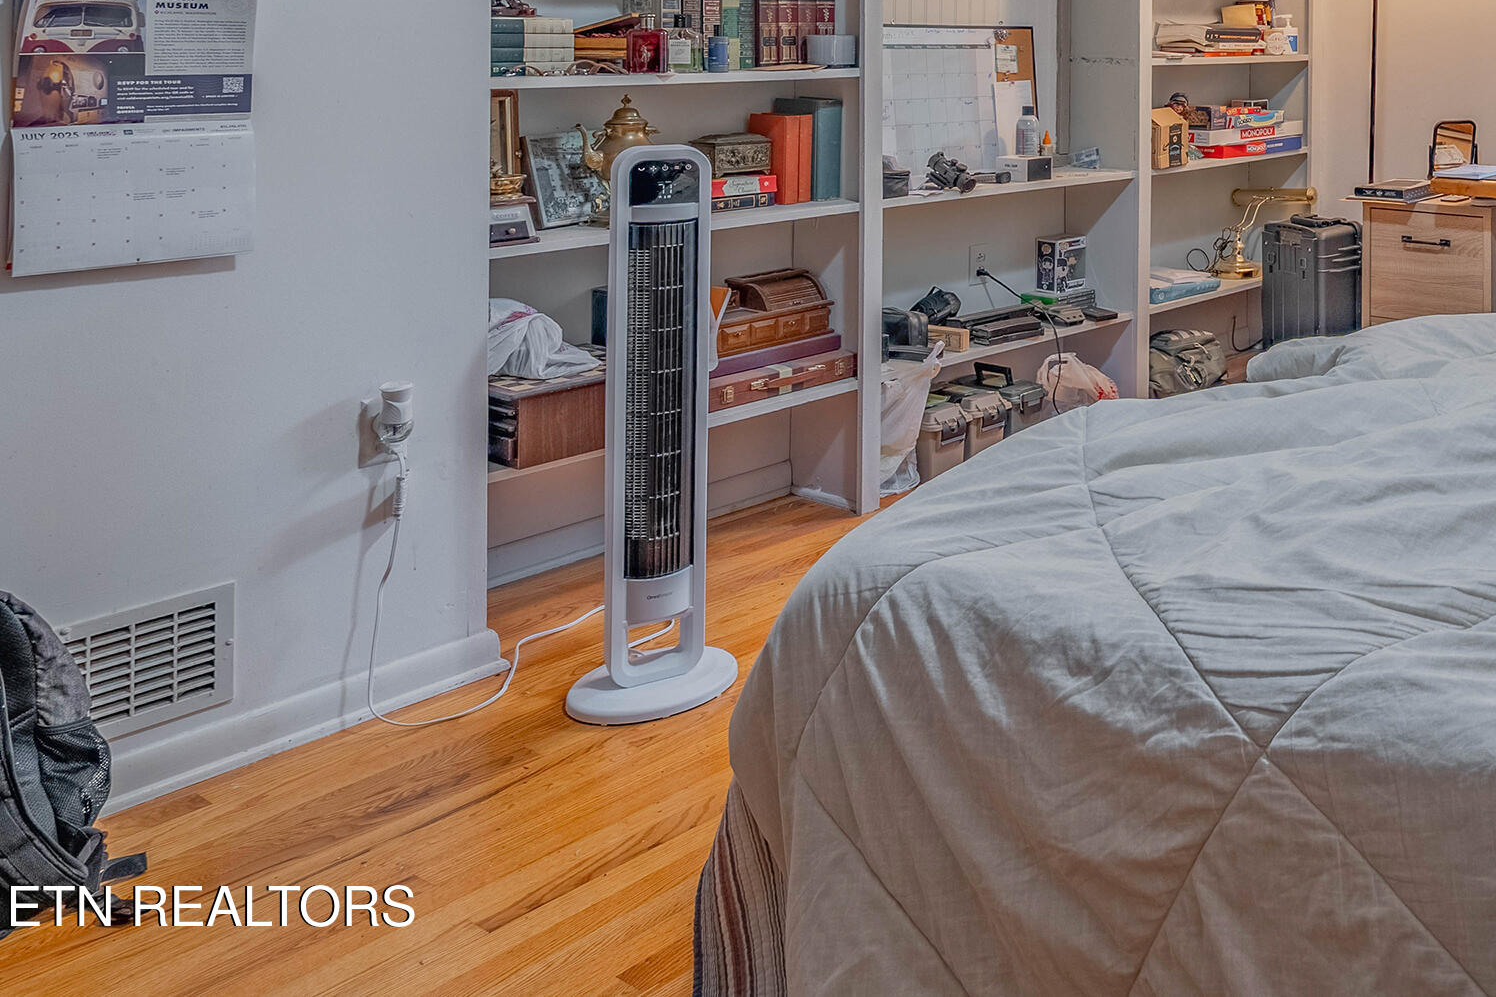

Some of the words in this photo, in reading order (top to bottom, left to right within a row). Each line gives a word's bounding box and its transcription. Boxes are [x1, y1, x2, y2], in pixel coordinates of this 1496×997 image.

[20, 132, 46, 141] JULY
[50, 131, 80, 140] 2025
[1241, 126, 1274, 139] MONOPOLY
